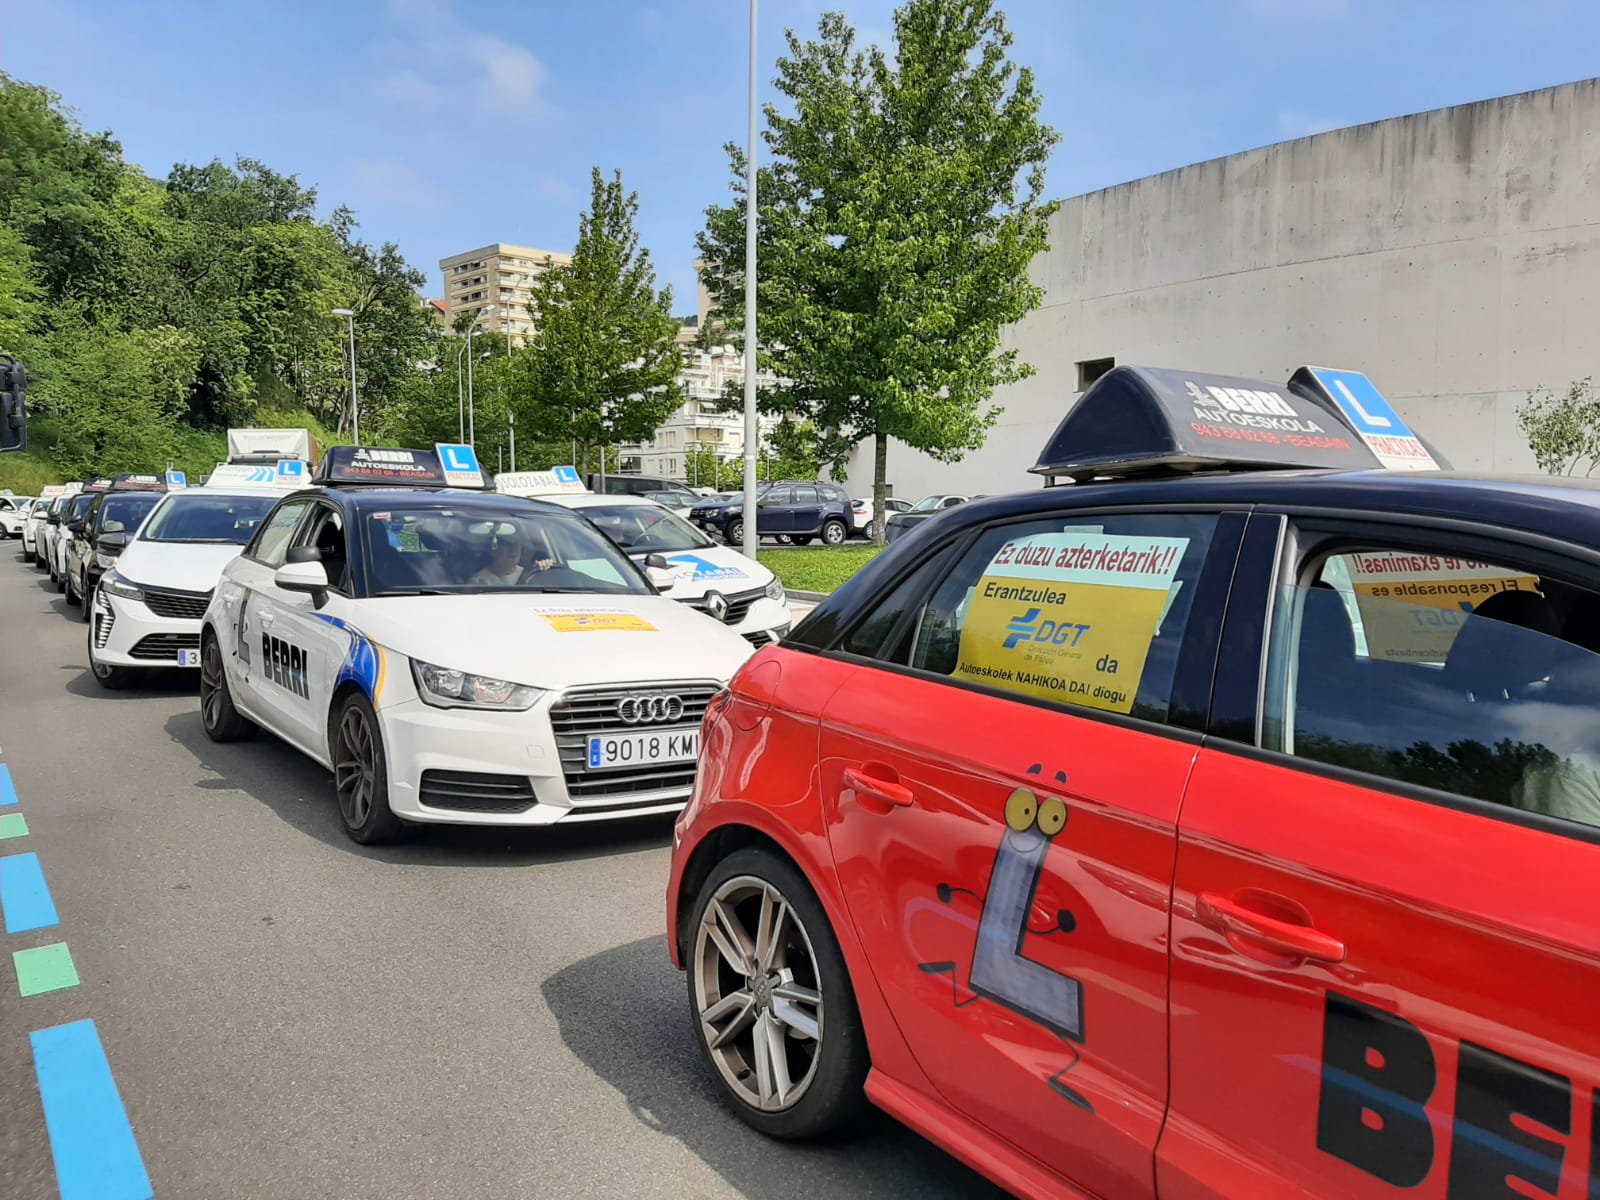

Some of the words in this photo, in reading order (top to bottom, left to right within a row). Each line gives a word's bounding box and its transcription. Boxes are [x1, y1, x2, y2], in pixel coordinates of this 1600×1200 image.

[1206, 386, 1299, 416] BERRI
[1334, 379, 1392, 427] L
[1195, 406, 1325, 433] AUTOESKOLA
[284, 462, 297, 474] L
[351, 460, 426, 472] AUTOESKOLA
[448, 449, 470, 469] L
[170, 473, 182, 484] L
[559, 469, 574, 481] L
[994, 543, 1016, 565] Ez
[1015, 541, 1056, 567] duzu
[1055, 543, 1179, 575] azterketarik!!
[984, 582, 1067, 605] Erantzulea
[1034, 620, 1091, 648] DGT
[189, 652, 198, 665] 3
[262, 632, 310, 701] BERRI
[1096, 654, 1119, 674] da
[959, 662, 1013, 682] Autoeskolek
[1015, 671, 1067, 691] NAHIKOA
[1068, 681, 1090, 696] DA!
[1093, 686, 1127, 704] diogu
[606, 738, 660, 761] 9018
[1316, 989, 1600, 1200] BE
